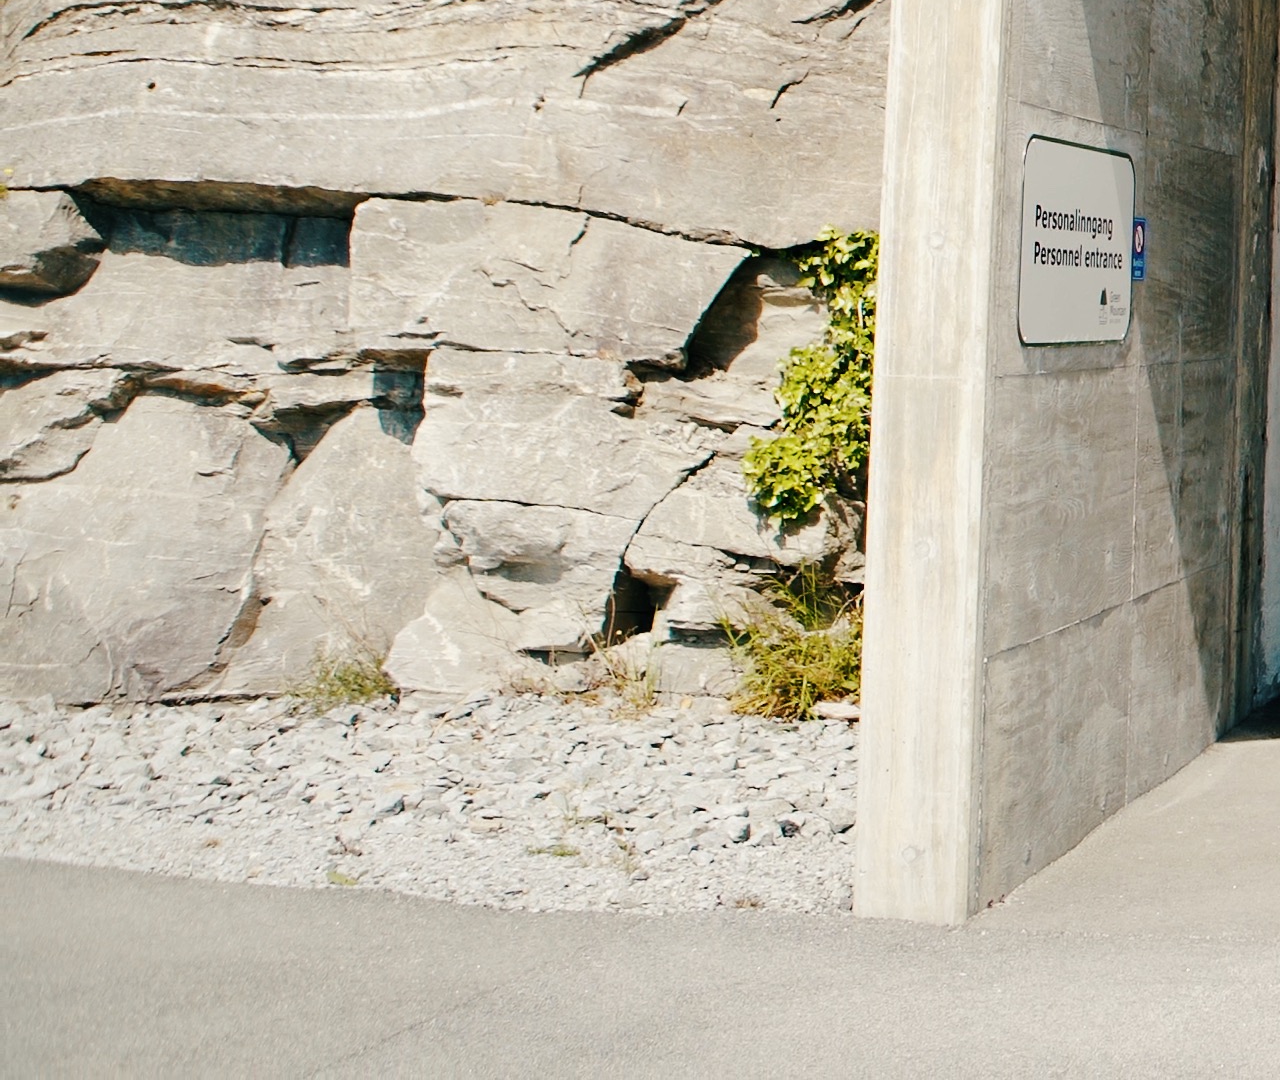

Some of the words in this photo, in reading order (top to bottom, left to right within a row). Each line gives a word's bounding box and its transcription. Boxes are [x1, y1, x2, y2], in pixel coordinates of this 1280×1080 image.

[1035, 204, 1113, 240] Personalinngang
[1034, 241, 1083, 267] Personnel
[1084, 247, 1123, 269] entrance
